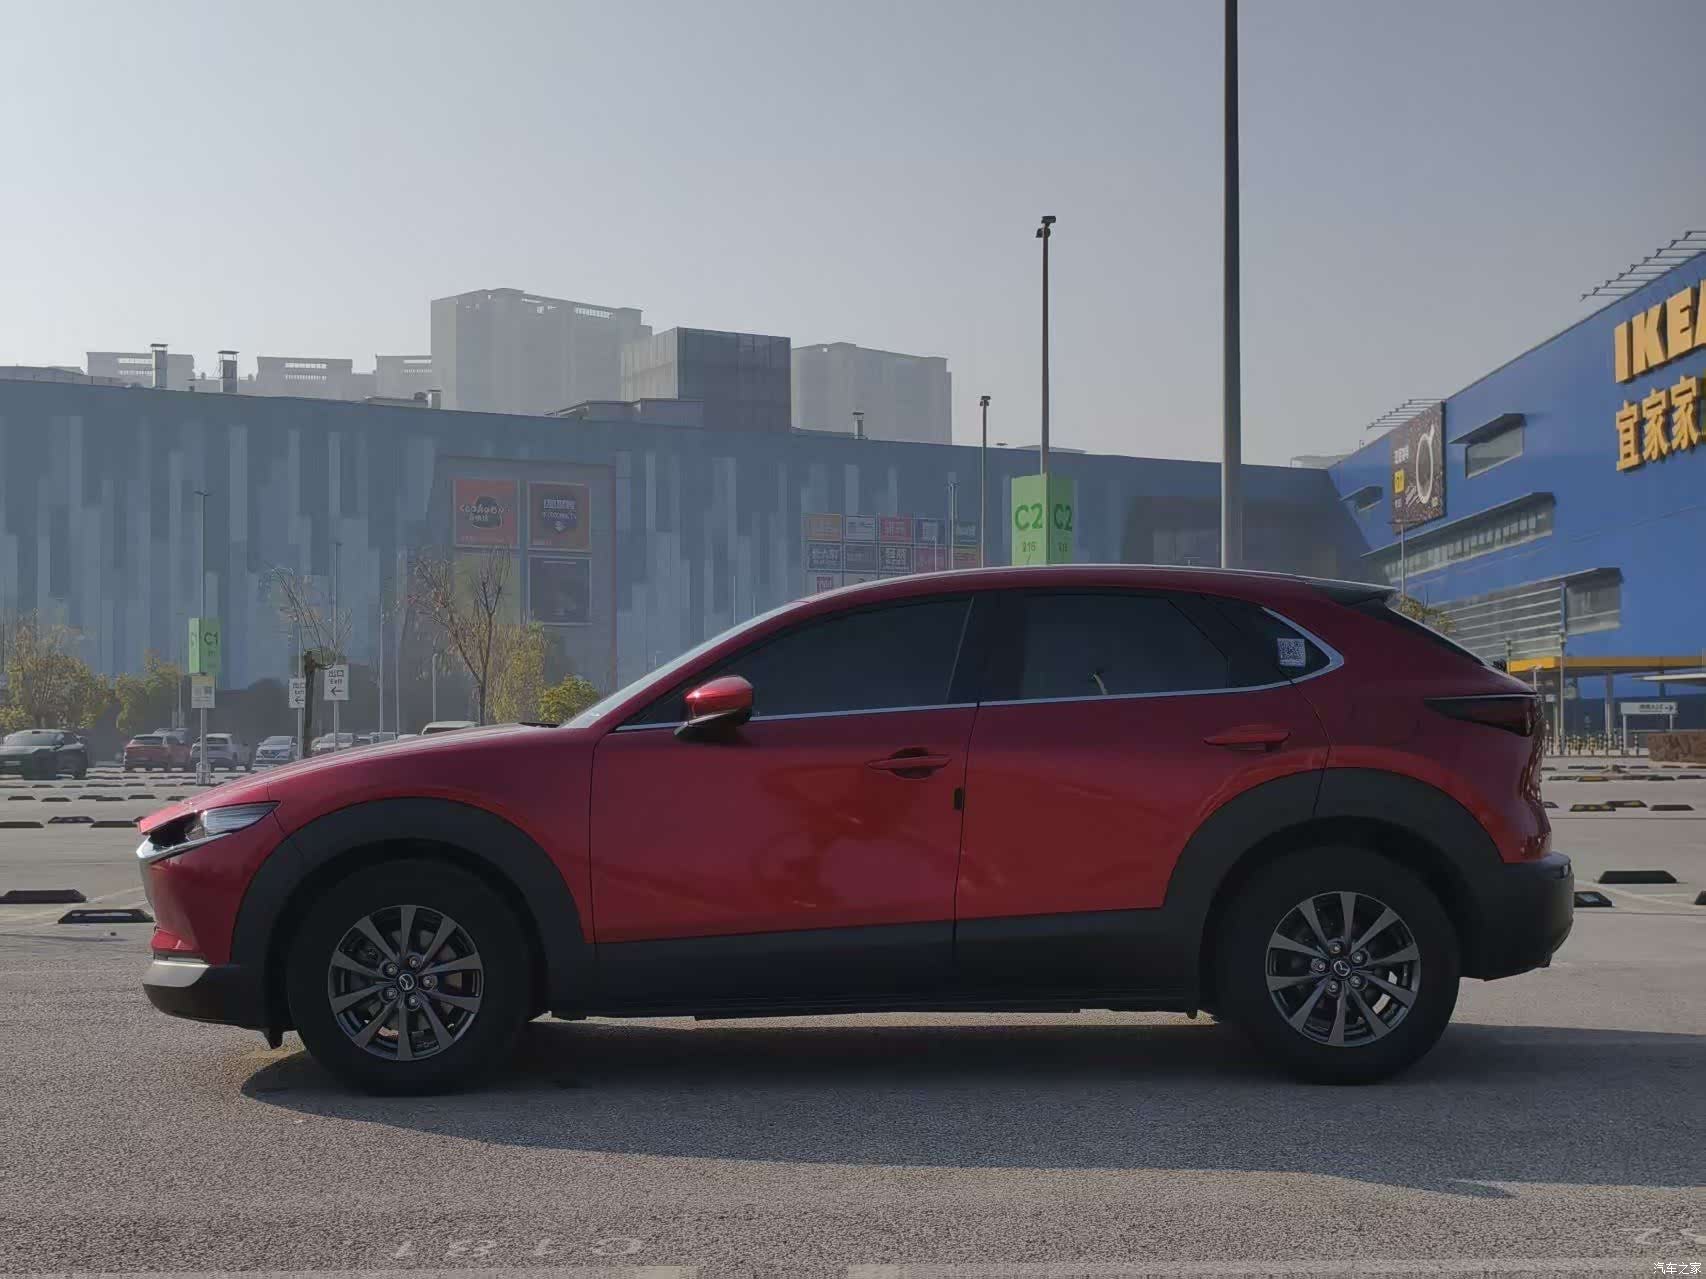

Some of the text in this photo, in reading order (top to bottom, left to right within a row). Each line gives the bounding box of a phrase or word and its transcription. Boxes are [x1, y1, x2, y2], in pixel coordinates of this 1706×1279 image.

[1615, 375, 1699, 472] 宜家家
[1014, 503, 1043, 531] C2
[1053, 503, 1073, 532] C2
[204, 631, 218, 646] C1
[328, 669, 345, 678] 出口
